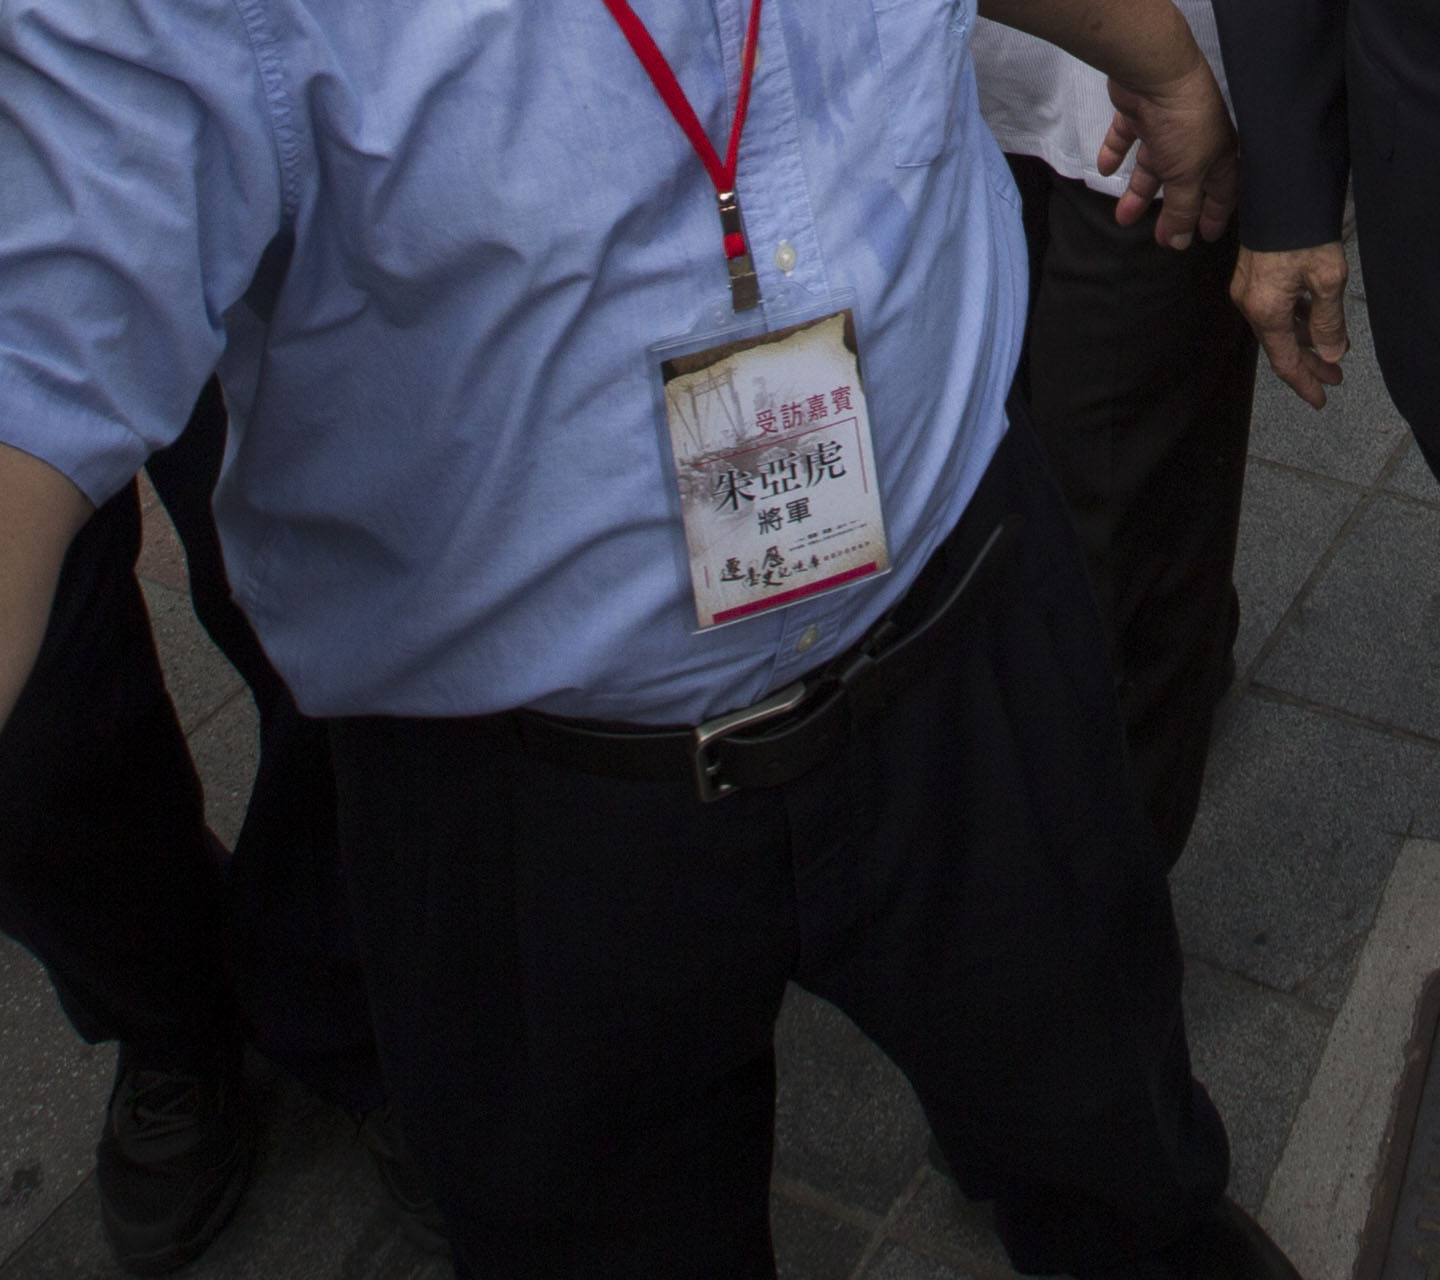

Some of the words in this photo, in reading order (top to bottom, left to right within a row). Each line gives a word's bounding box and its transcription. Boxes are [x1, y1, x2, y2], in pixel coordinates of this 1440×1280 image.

[754, 385, 854, 436] 受訪嘉賓
[714, 439, 848, 514] 朱亞虎
[757, 495, 813, 536] 將軍
